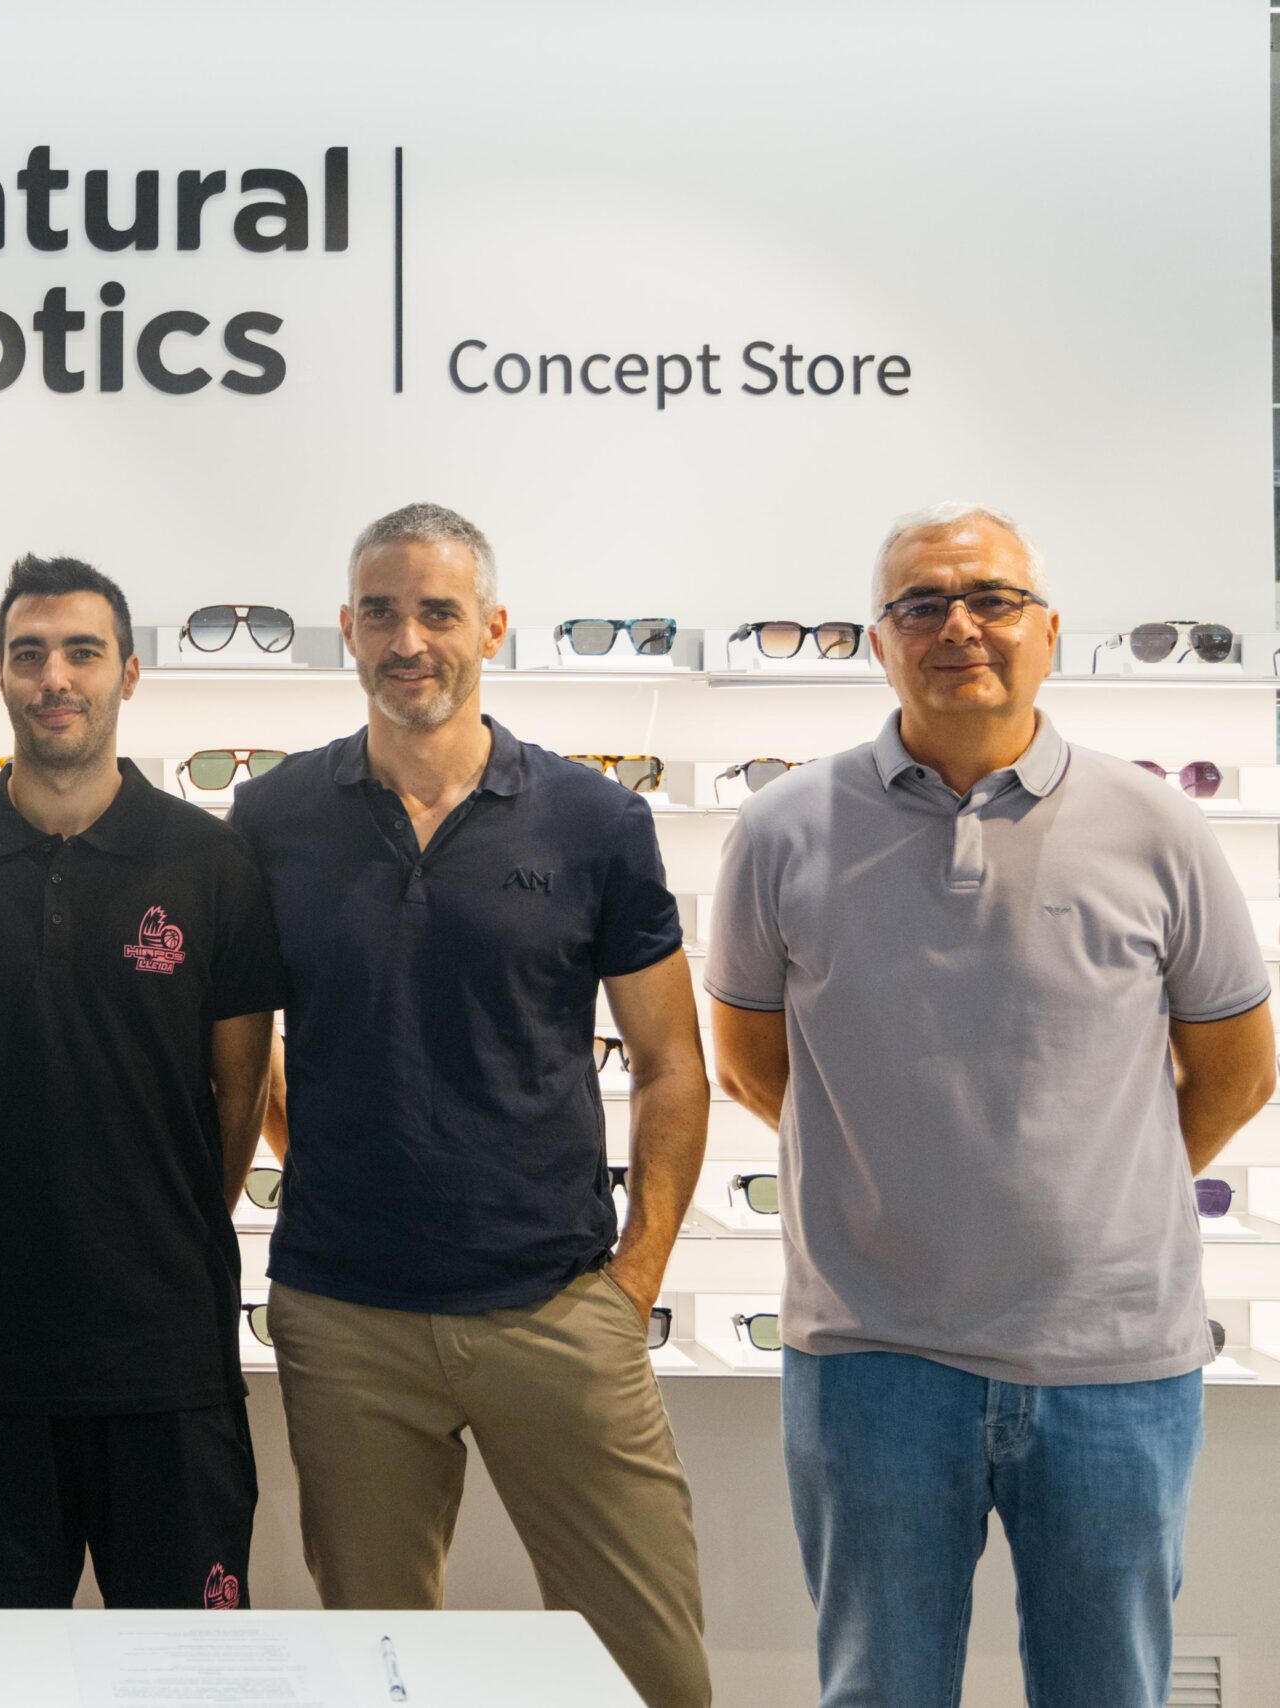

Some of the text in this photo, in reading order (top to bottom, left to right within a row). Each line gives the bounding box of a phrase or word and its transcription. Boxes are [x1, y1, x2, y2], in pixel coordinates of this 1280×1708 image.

[449, 339, 911, 410] Concept Store
[138, 959, 173, 972] LLEIDA
